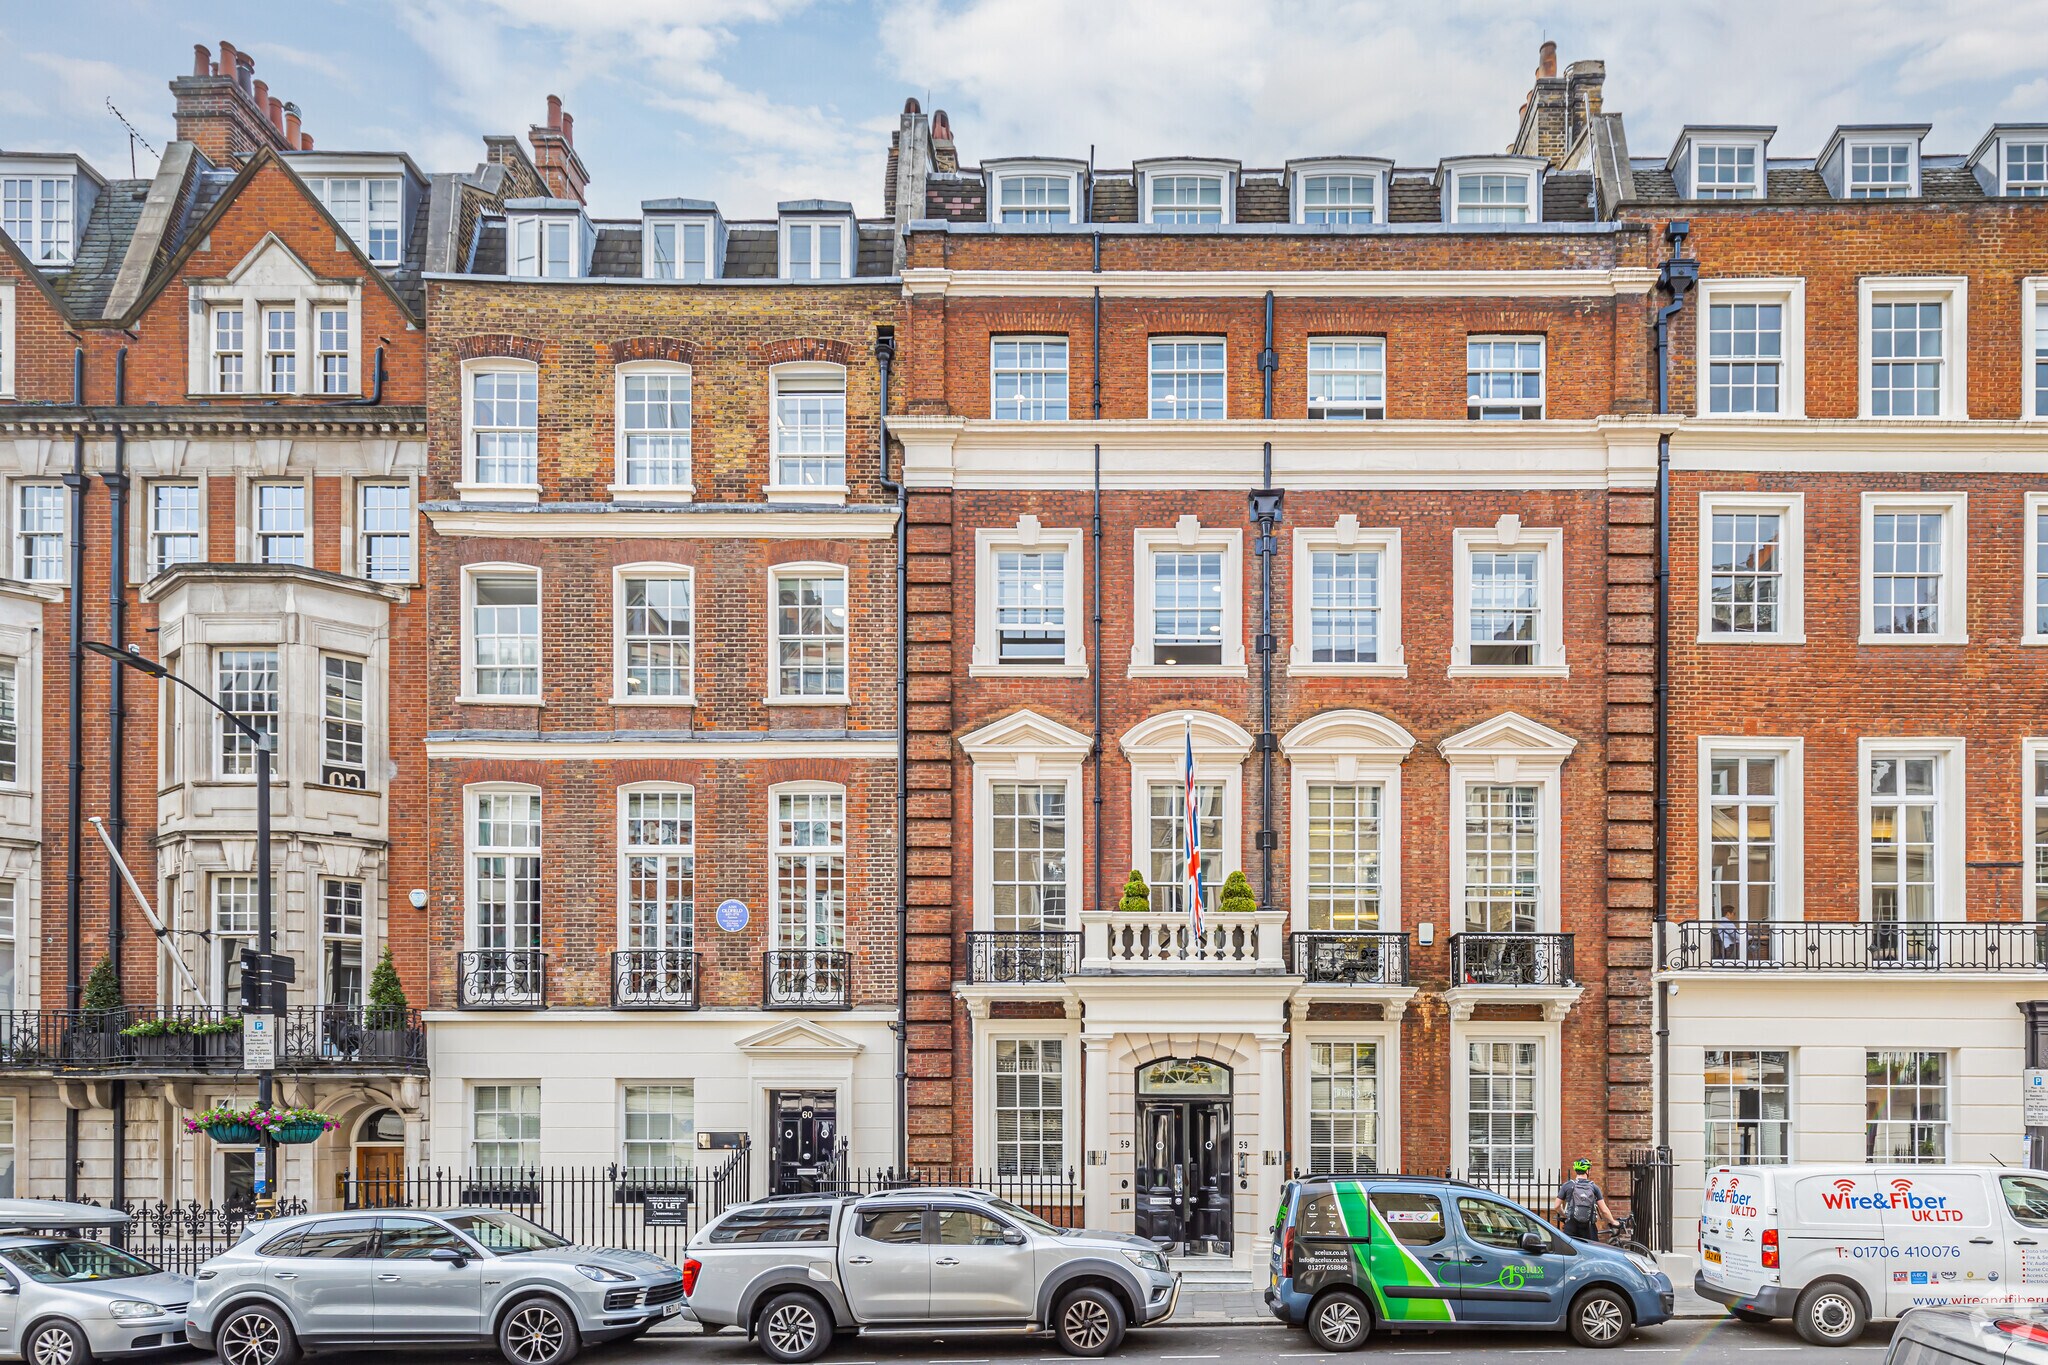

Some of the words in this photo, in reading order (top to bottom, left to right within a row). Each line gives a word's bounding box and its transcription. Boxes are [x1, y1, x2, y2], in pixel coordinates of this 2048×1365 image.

[802, 1110, 813, 1119] 60
[1120, 1140, 1130, 1148] 59
[1239, 1141, 1248, 1149] 59
[1706, 1188, 1751, 1205] Wire&Fiber
[1821, 1192, 1947, 1209] Wire&Fiber
[1731, 1205, 1741, 1215] UK
[1741, 1206, 1757, 1217] LTD
[1912, 1210, 1934, 1221] UK
[1936, 1210, 1963, 1221] LTD
[1835, 1246, 1848, 1258] T:
[1853, 1246, 1900, 1258] 01706
[1904, 1246, 1961, 1258] 410076
